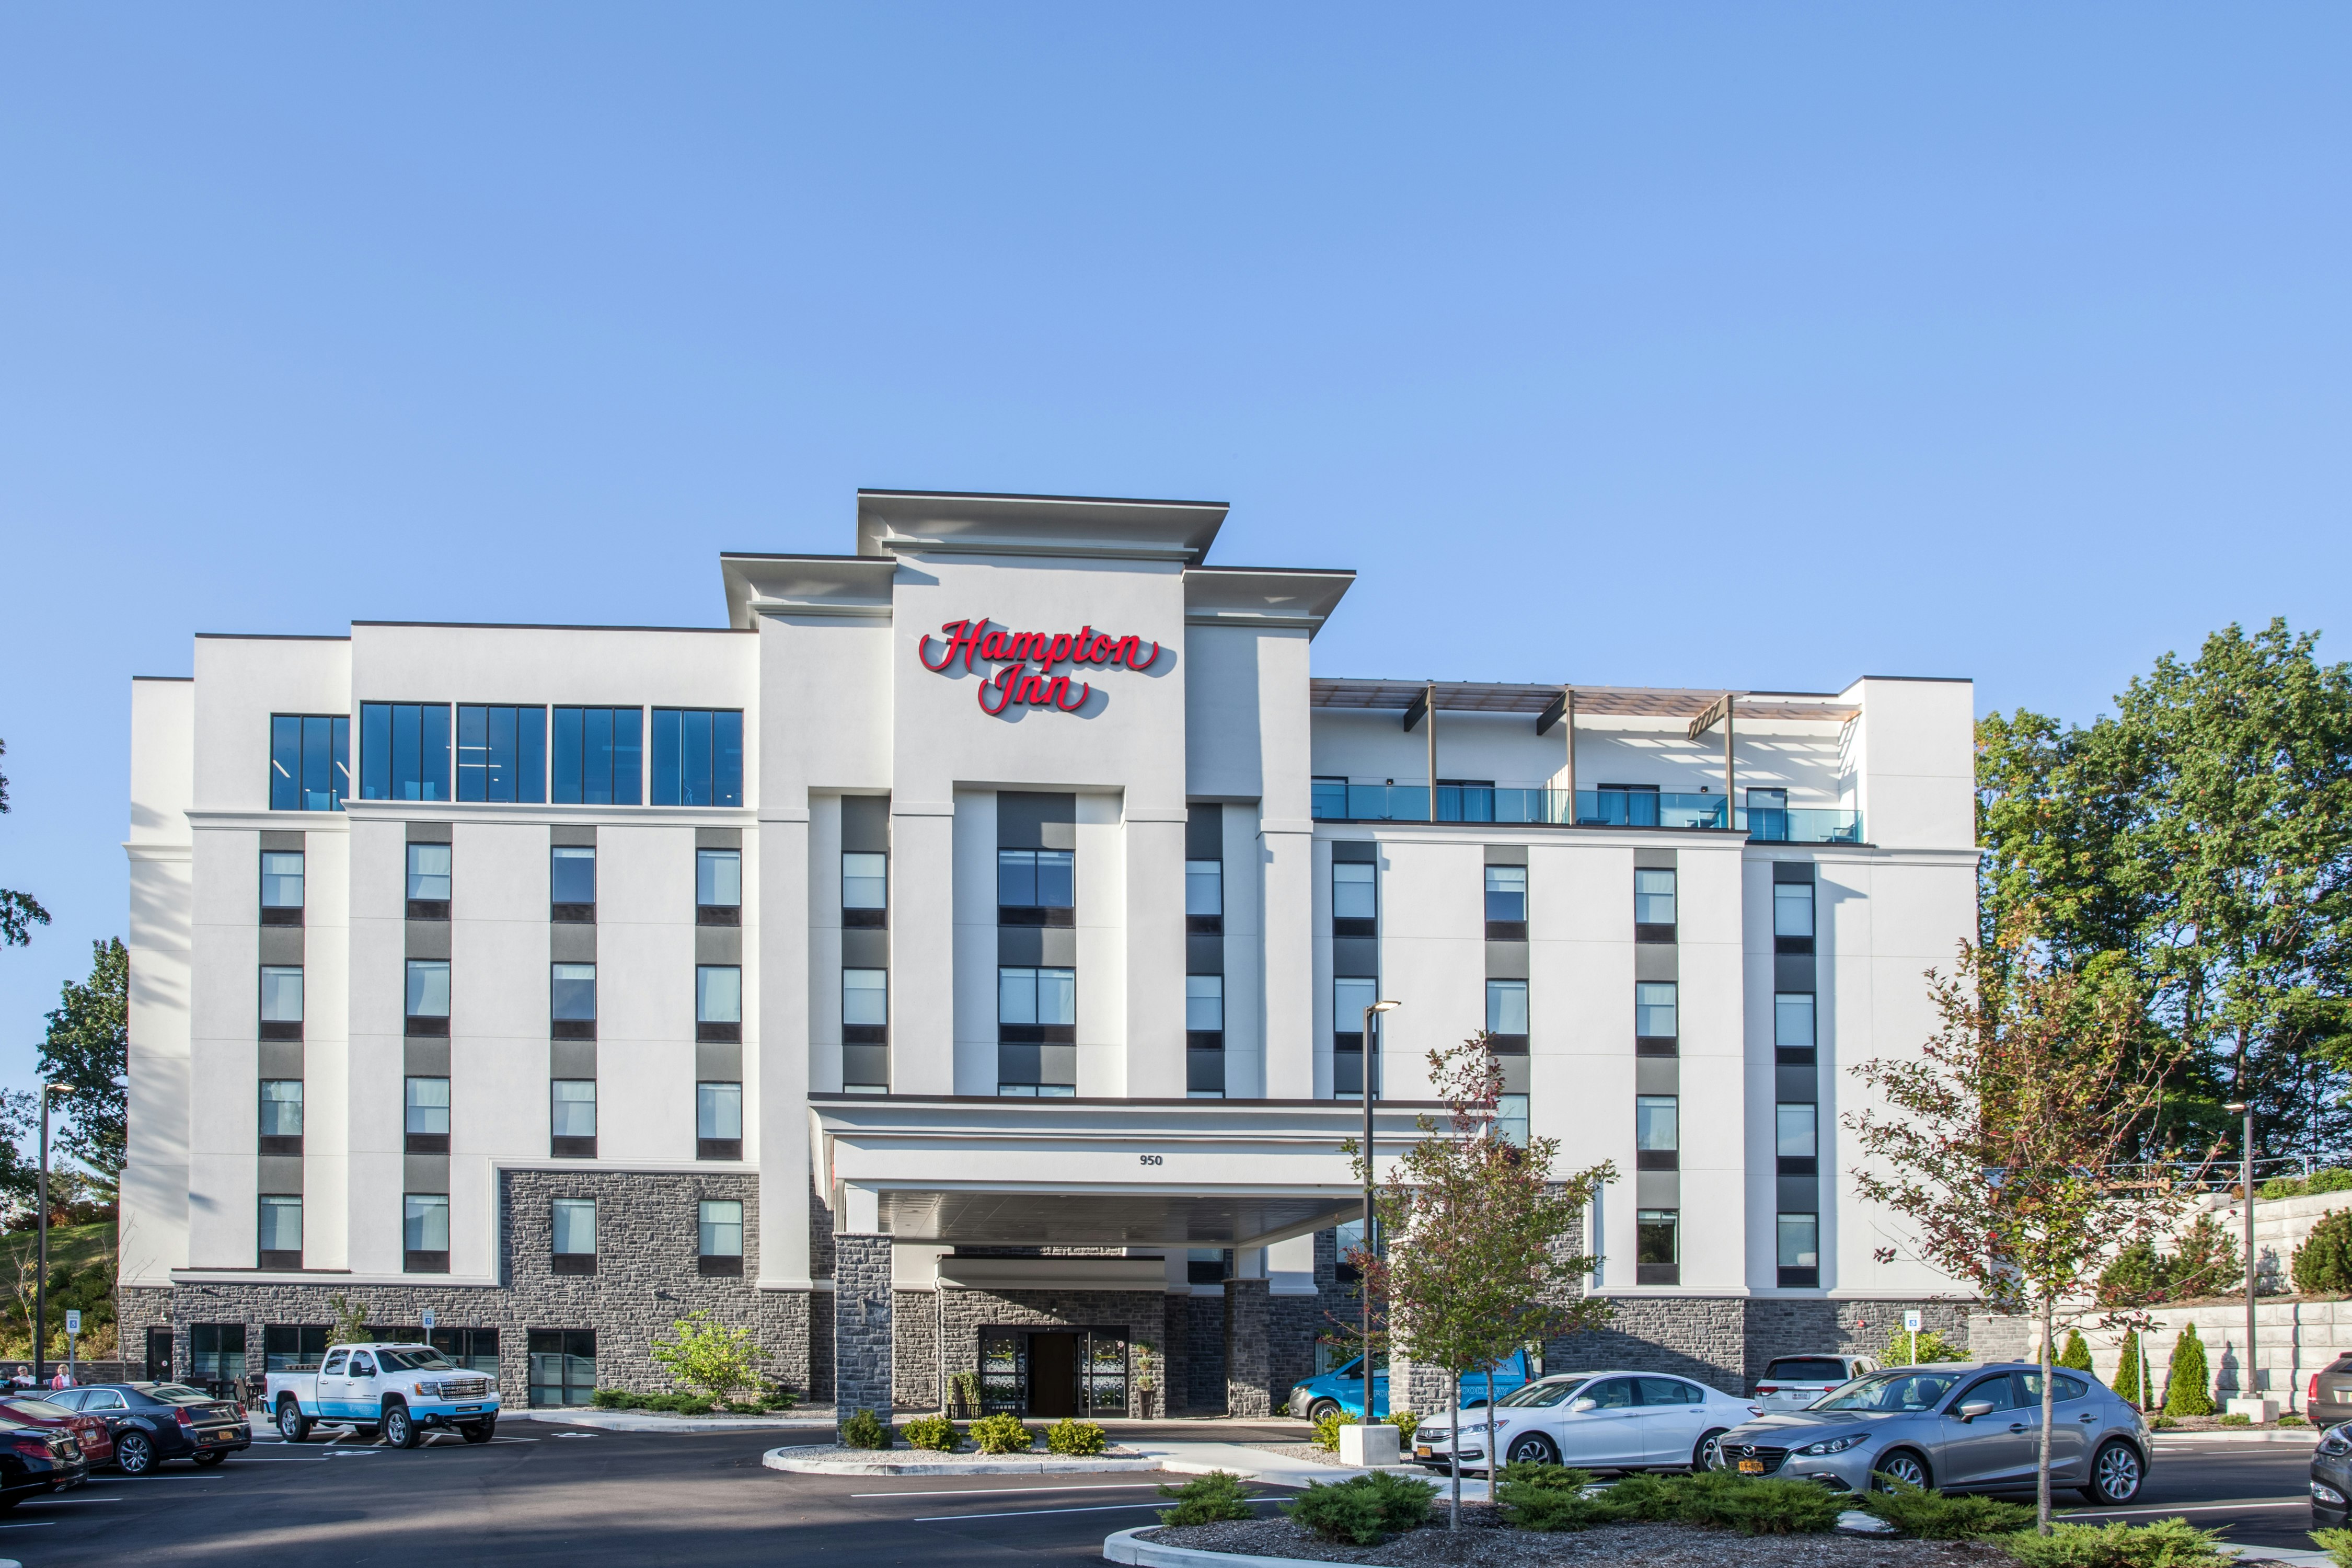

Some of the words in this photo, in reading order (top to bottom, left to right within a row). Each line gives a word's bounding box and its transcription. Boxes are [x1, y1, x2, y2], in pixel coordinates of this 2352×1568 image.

[918, 617, 1159, 674] Hampton
[977, 663, 1089, 716] Inn
[1140, 1155, 1162, 1166] 950
[1460, 1386, 1484, 1394] OOD
[1486, 1387, 1509, 1395] AY
